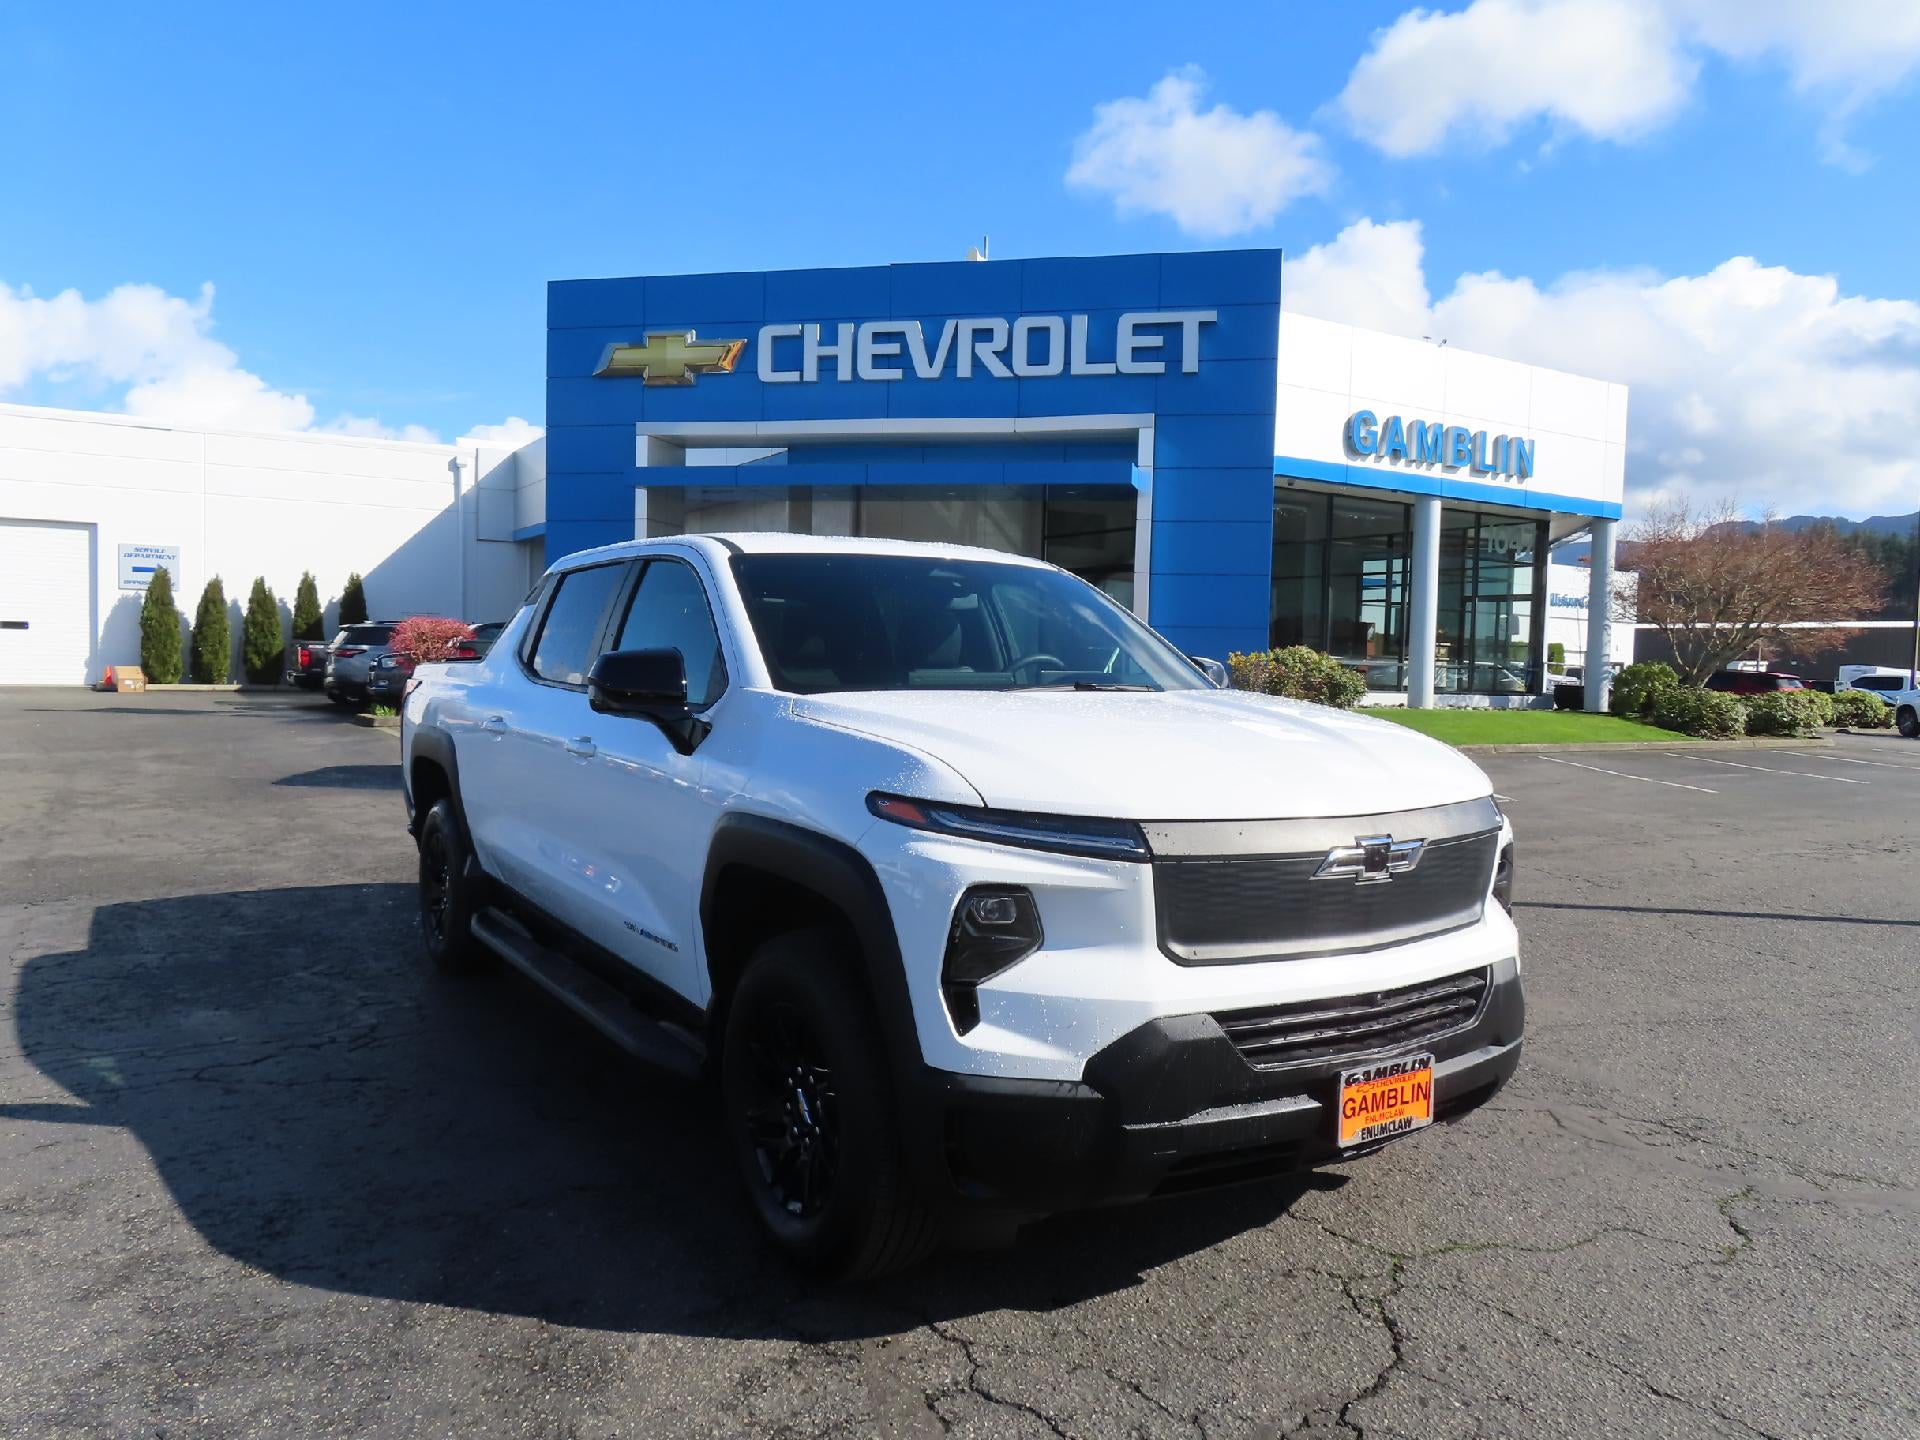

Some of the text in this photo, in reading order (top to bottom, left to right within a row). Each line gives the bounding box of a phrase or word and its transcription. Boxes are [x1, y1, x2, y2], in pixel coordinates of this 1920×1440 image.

[758, 310, 1217, 383] CHEVROLET
[1344, 410, 1535, 478] GAMBLIN
[123, 552, 176, 560] DEPARTMENT
[1344, 1056, 1432, 1087] GAMBLIN
[1343, 1081, 1428, 1119] GAMBLIN
[1361, 1116, 1413, 1141] ENUMCLAW
